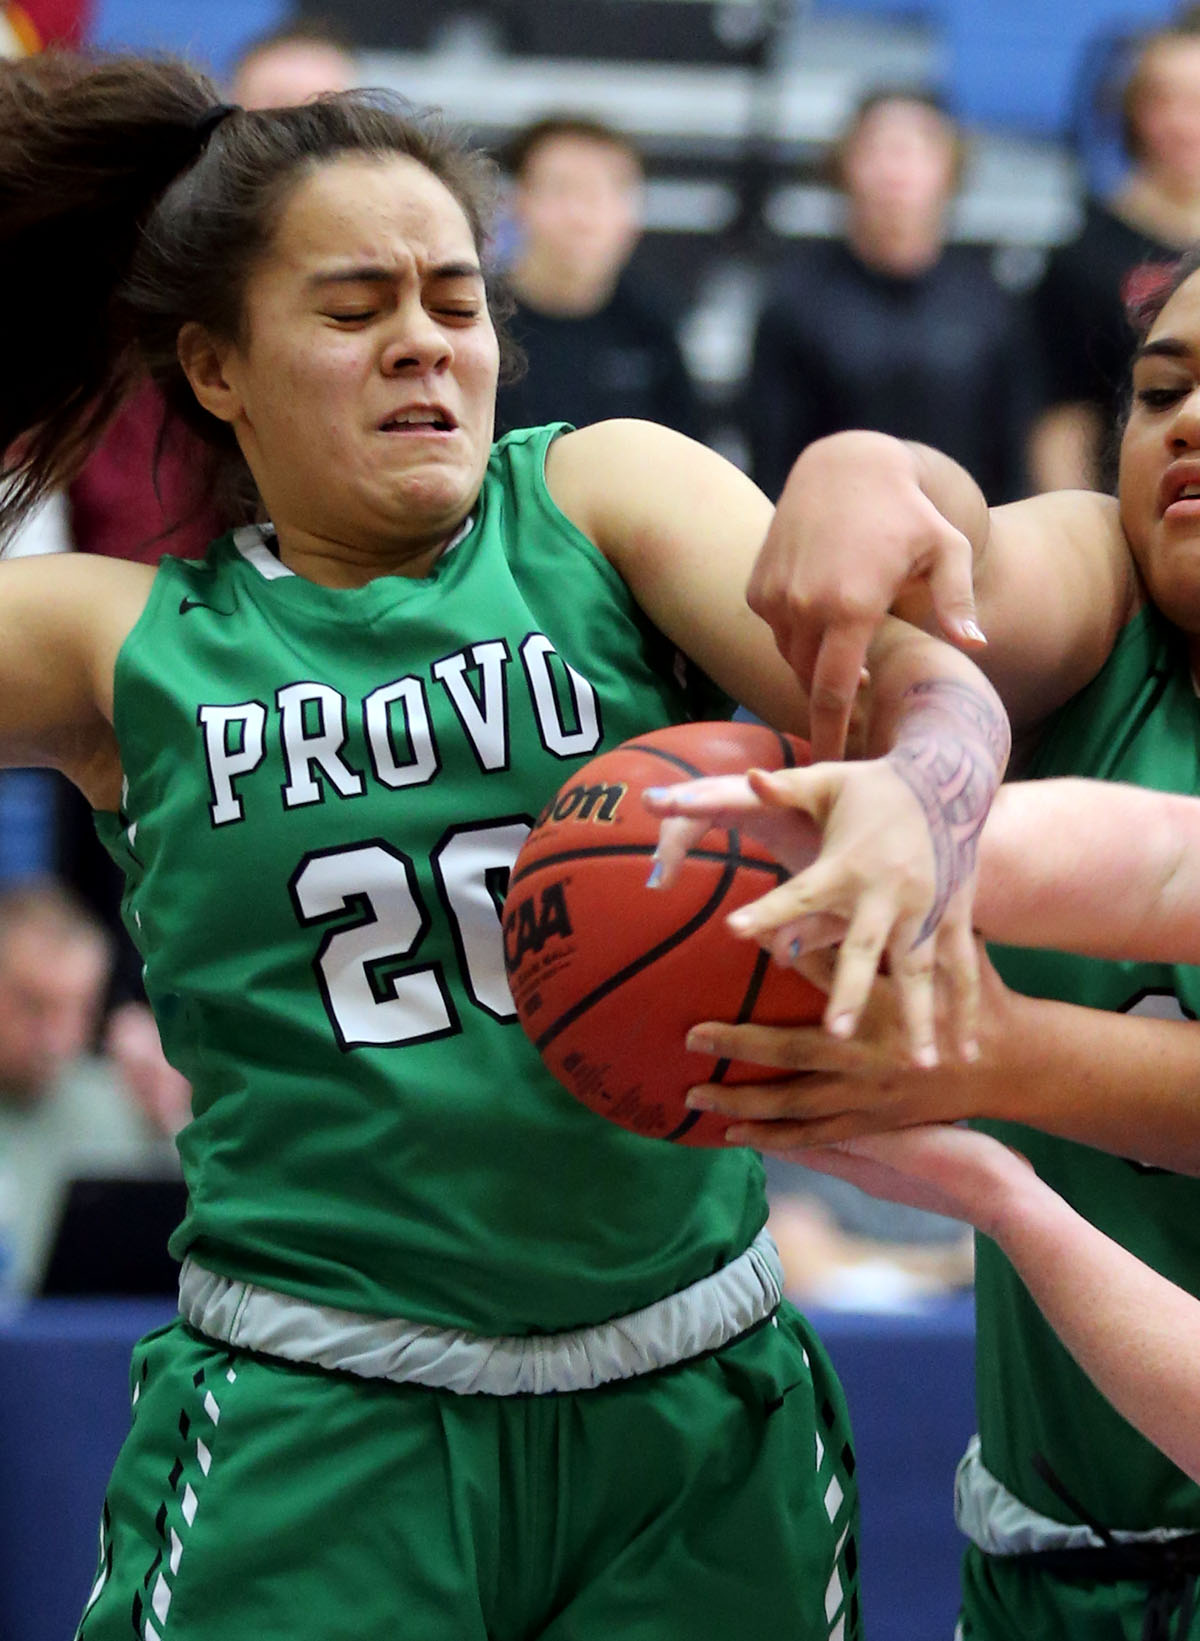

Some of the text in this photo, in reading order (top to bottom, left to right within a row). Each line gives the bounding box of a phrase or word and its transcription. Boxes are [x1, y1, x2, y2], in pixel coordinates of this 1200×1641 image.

[199, 632, 604, 828] PROVO
[538, 781, 629, 829] on
[503, 882, 574, 973] CAA
